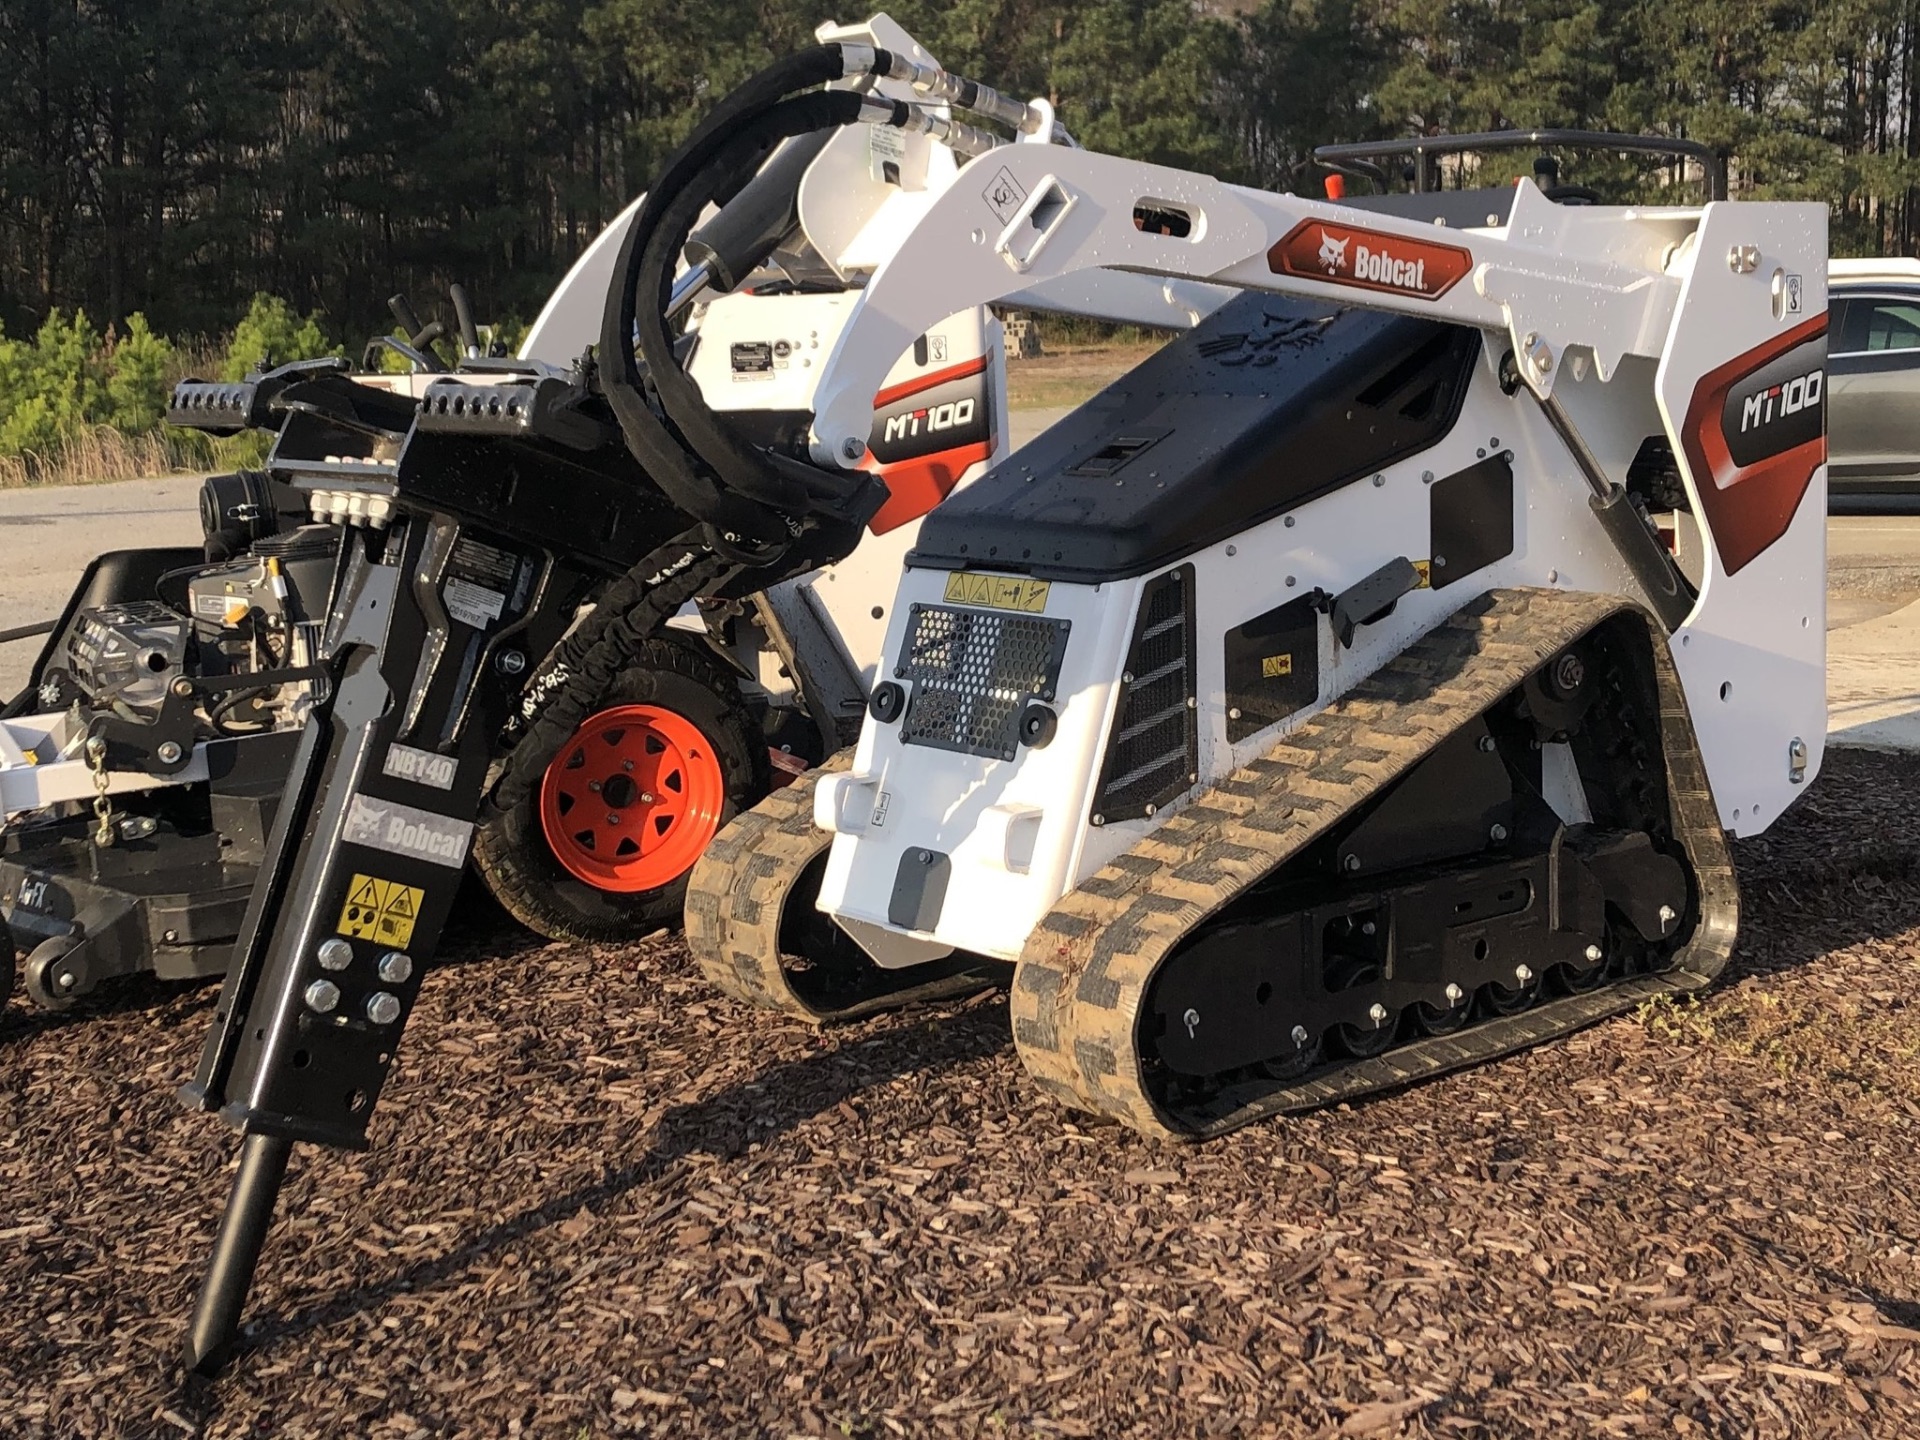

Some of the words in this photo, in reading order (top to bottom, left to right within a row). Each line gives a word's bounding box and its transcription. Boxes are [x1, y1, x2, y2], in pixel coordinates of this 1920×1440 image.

[1354, 245, 1426, 291] Bobcat
[884, 398, 975, 443] MT100
[1741, 369, 1823, 433] MT100
[387, 748, 453, 784] NB140
[386, 816, 465, 860] Bobcat
